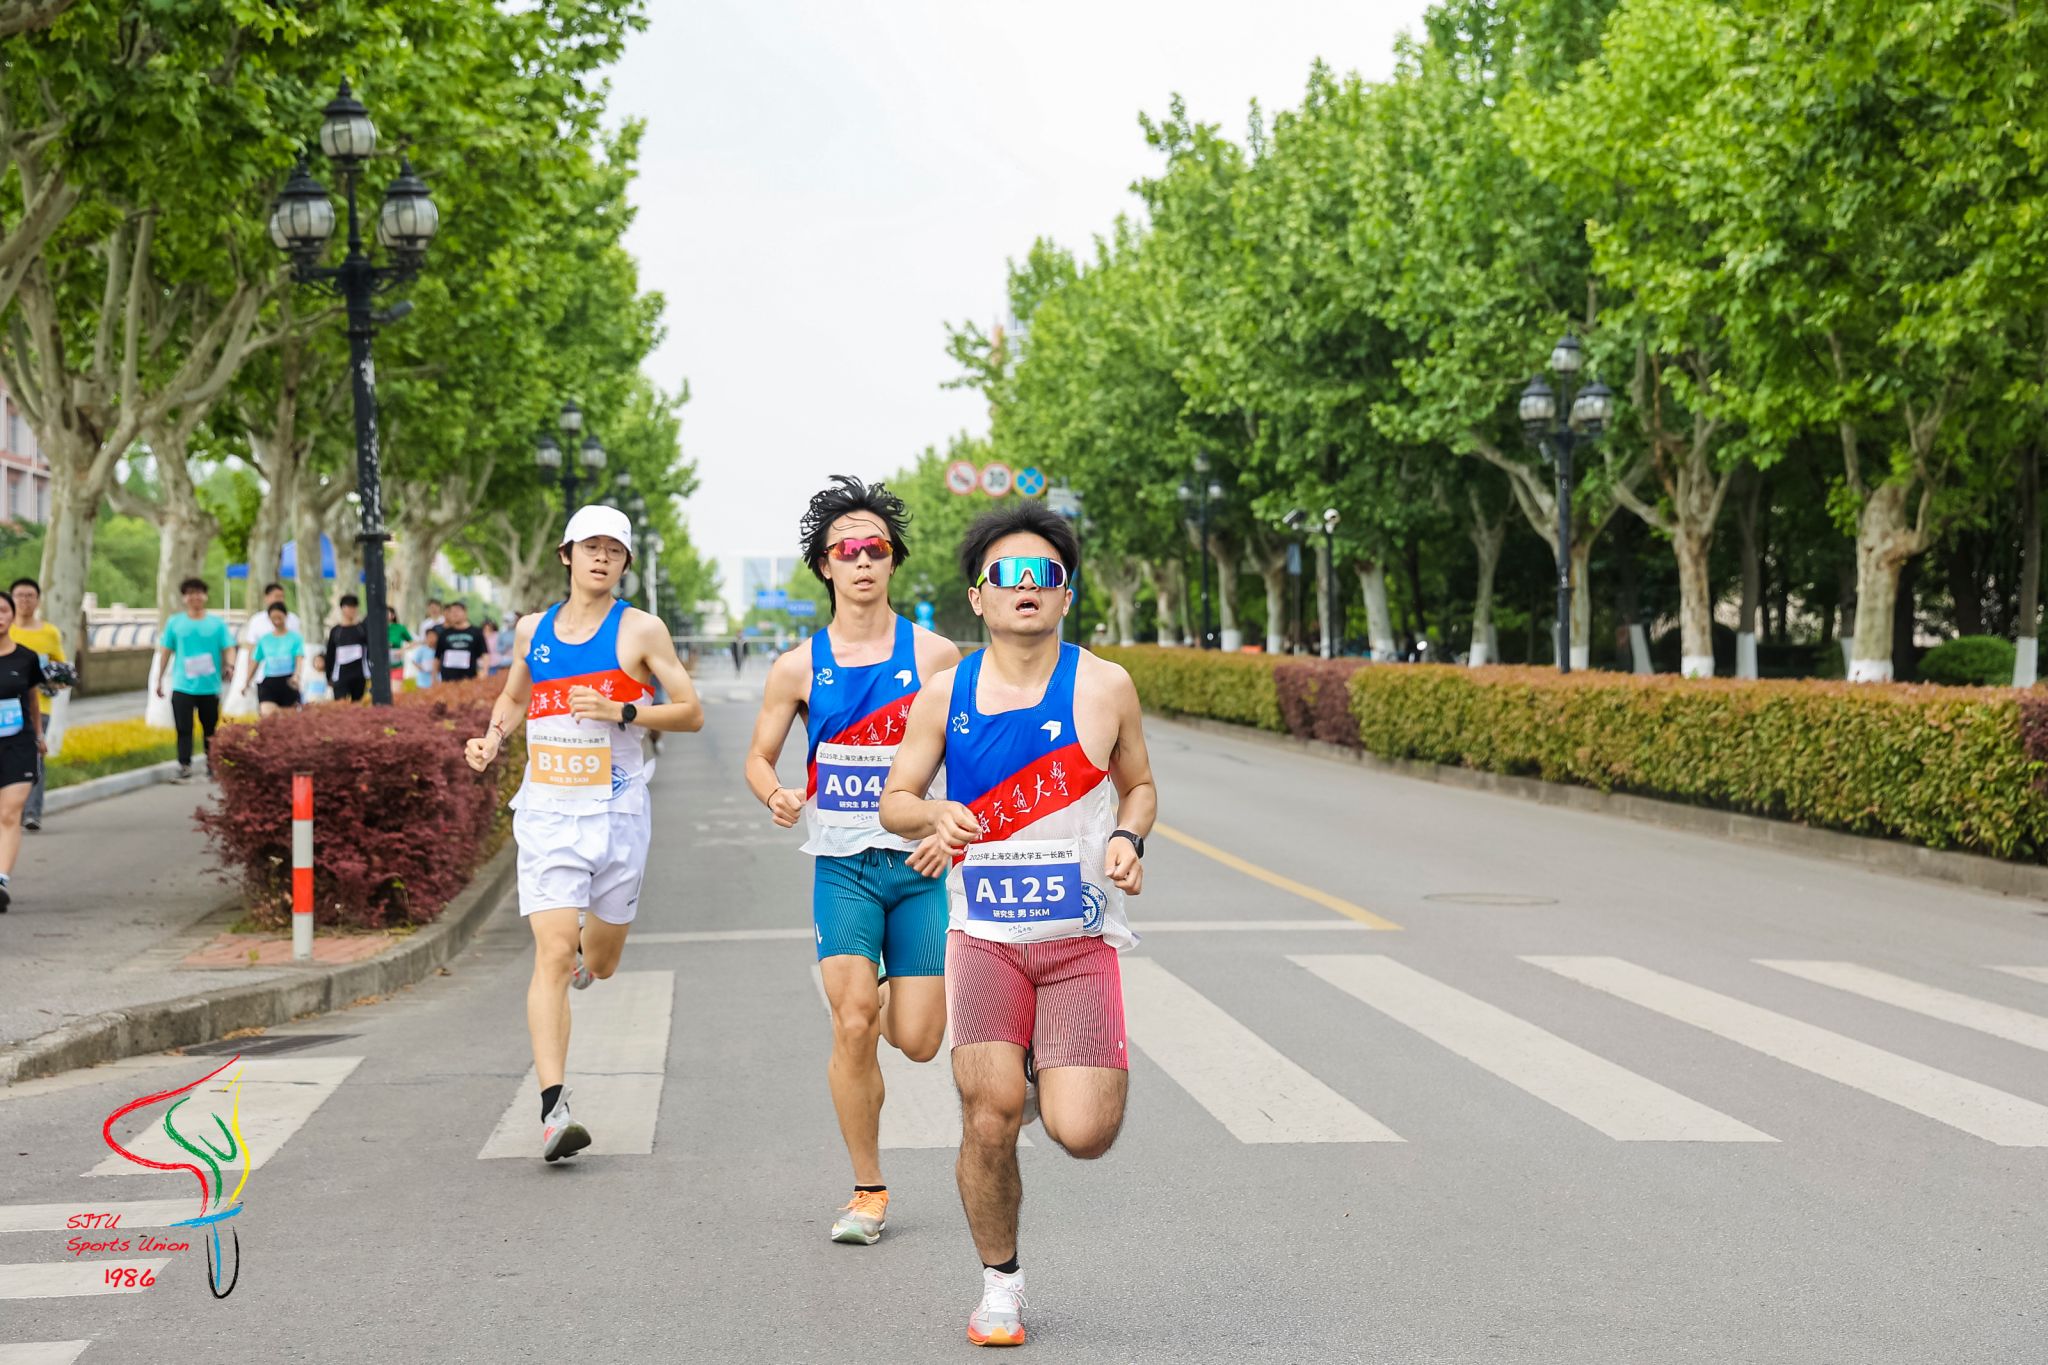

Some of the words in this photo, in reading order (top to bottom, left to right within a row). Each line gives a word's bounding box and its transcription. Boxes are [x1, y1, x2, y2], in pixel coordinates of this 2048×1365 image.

[538, 752, 600, 774] B169
[824, 774, 889, 797] A04
[969, 850, 1073, 861] 2025年上海交通大学五一长跑节
[975, 875, 1066, 904] A125
[993, 909, 1015, 918] 研究生
[1018, 909, 1026, 918] 男
[1029, 908, 1050, 917] 5KM
